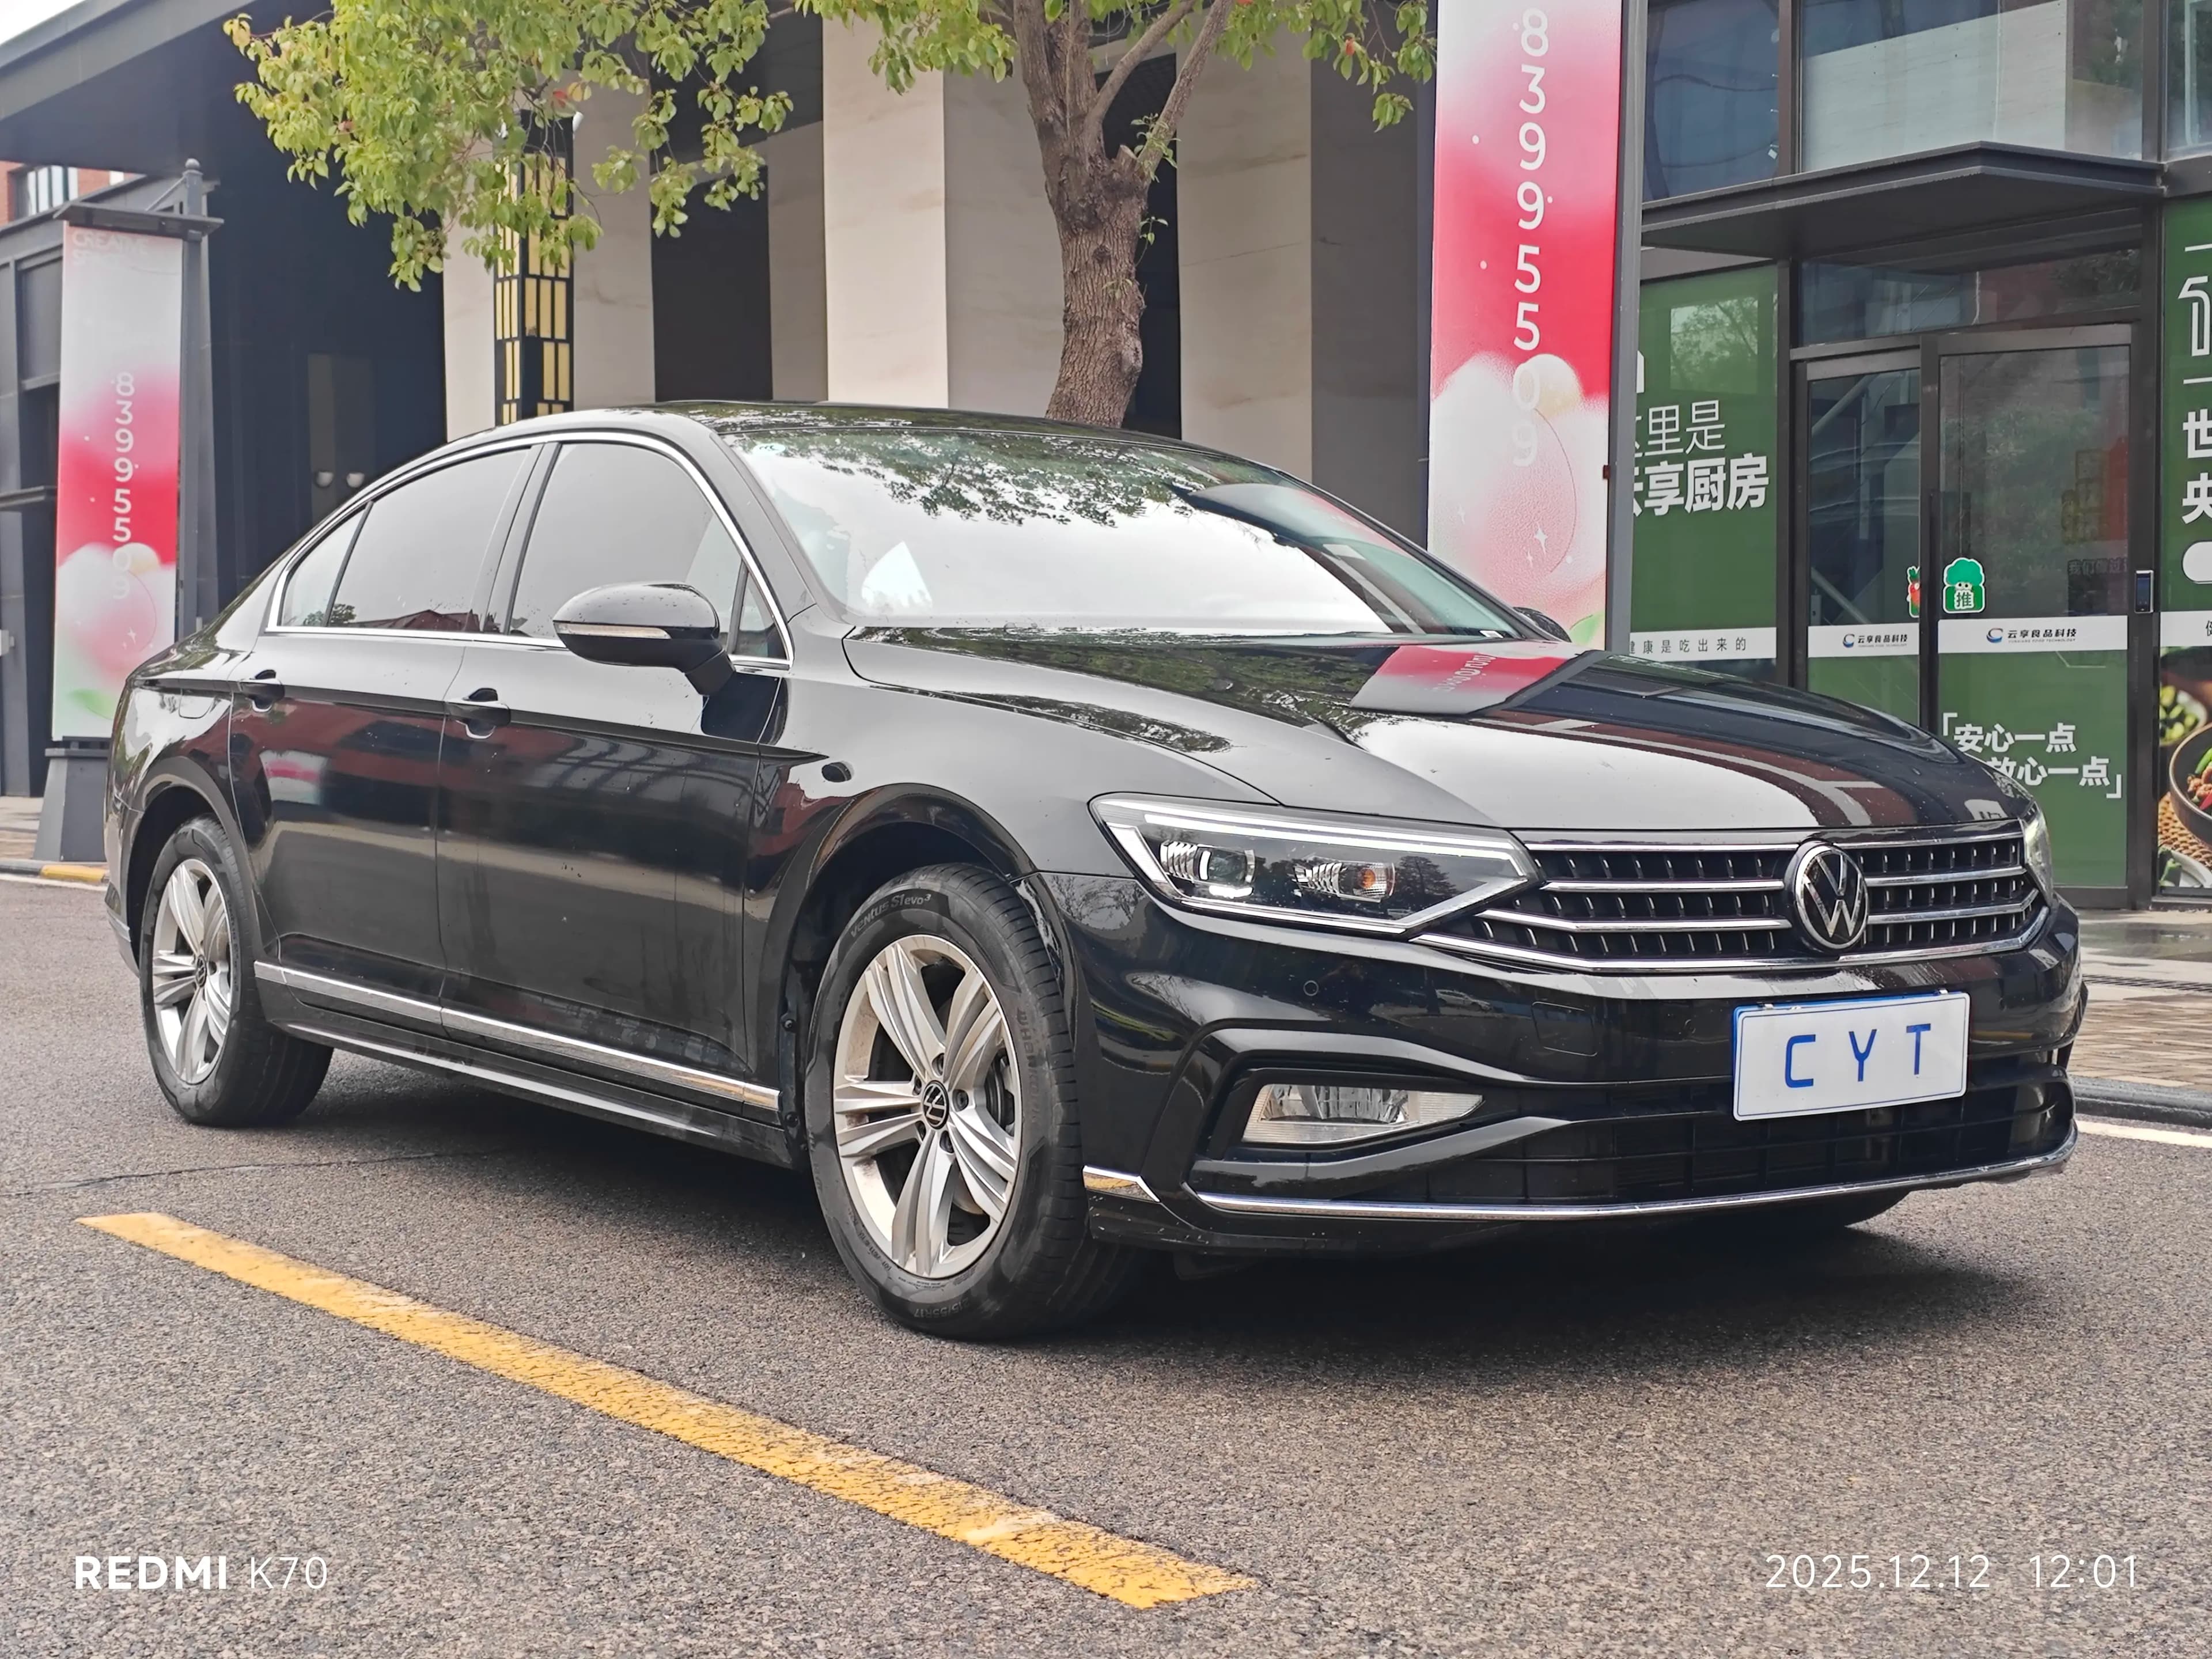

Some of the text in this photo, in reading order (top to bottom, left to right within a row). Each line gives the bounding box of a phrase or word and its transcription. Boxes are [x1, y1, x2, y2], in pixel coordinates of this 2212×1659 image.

[1634, 452, 1769, 517] 享厨房
[1956, 592, 1972, 607] 推
[2008, 628, 2077, 638] 云享食品科技
